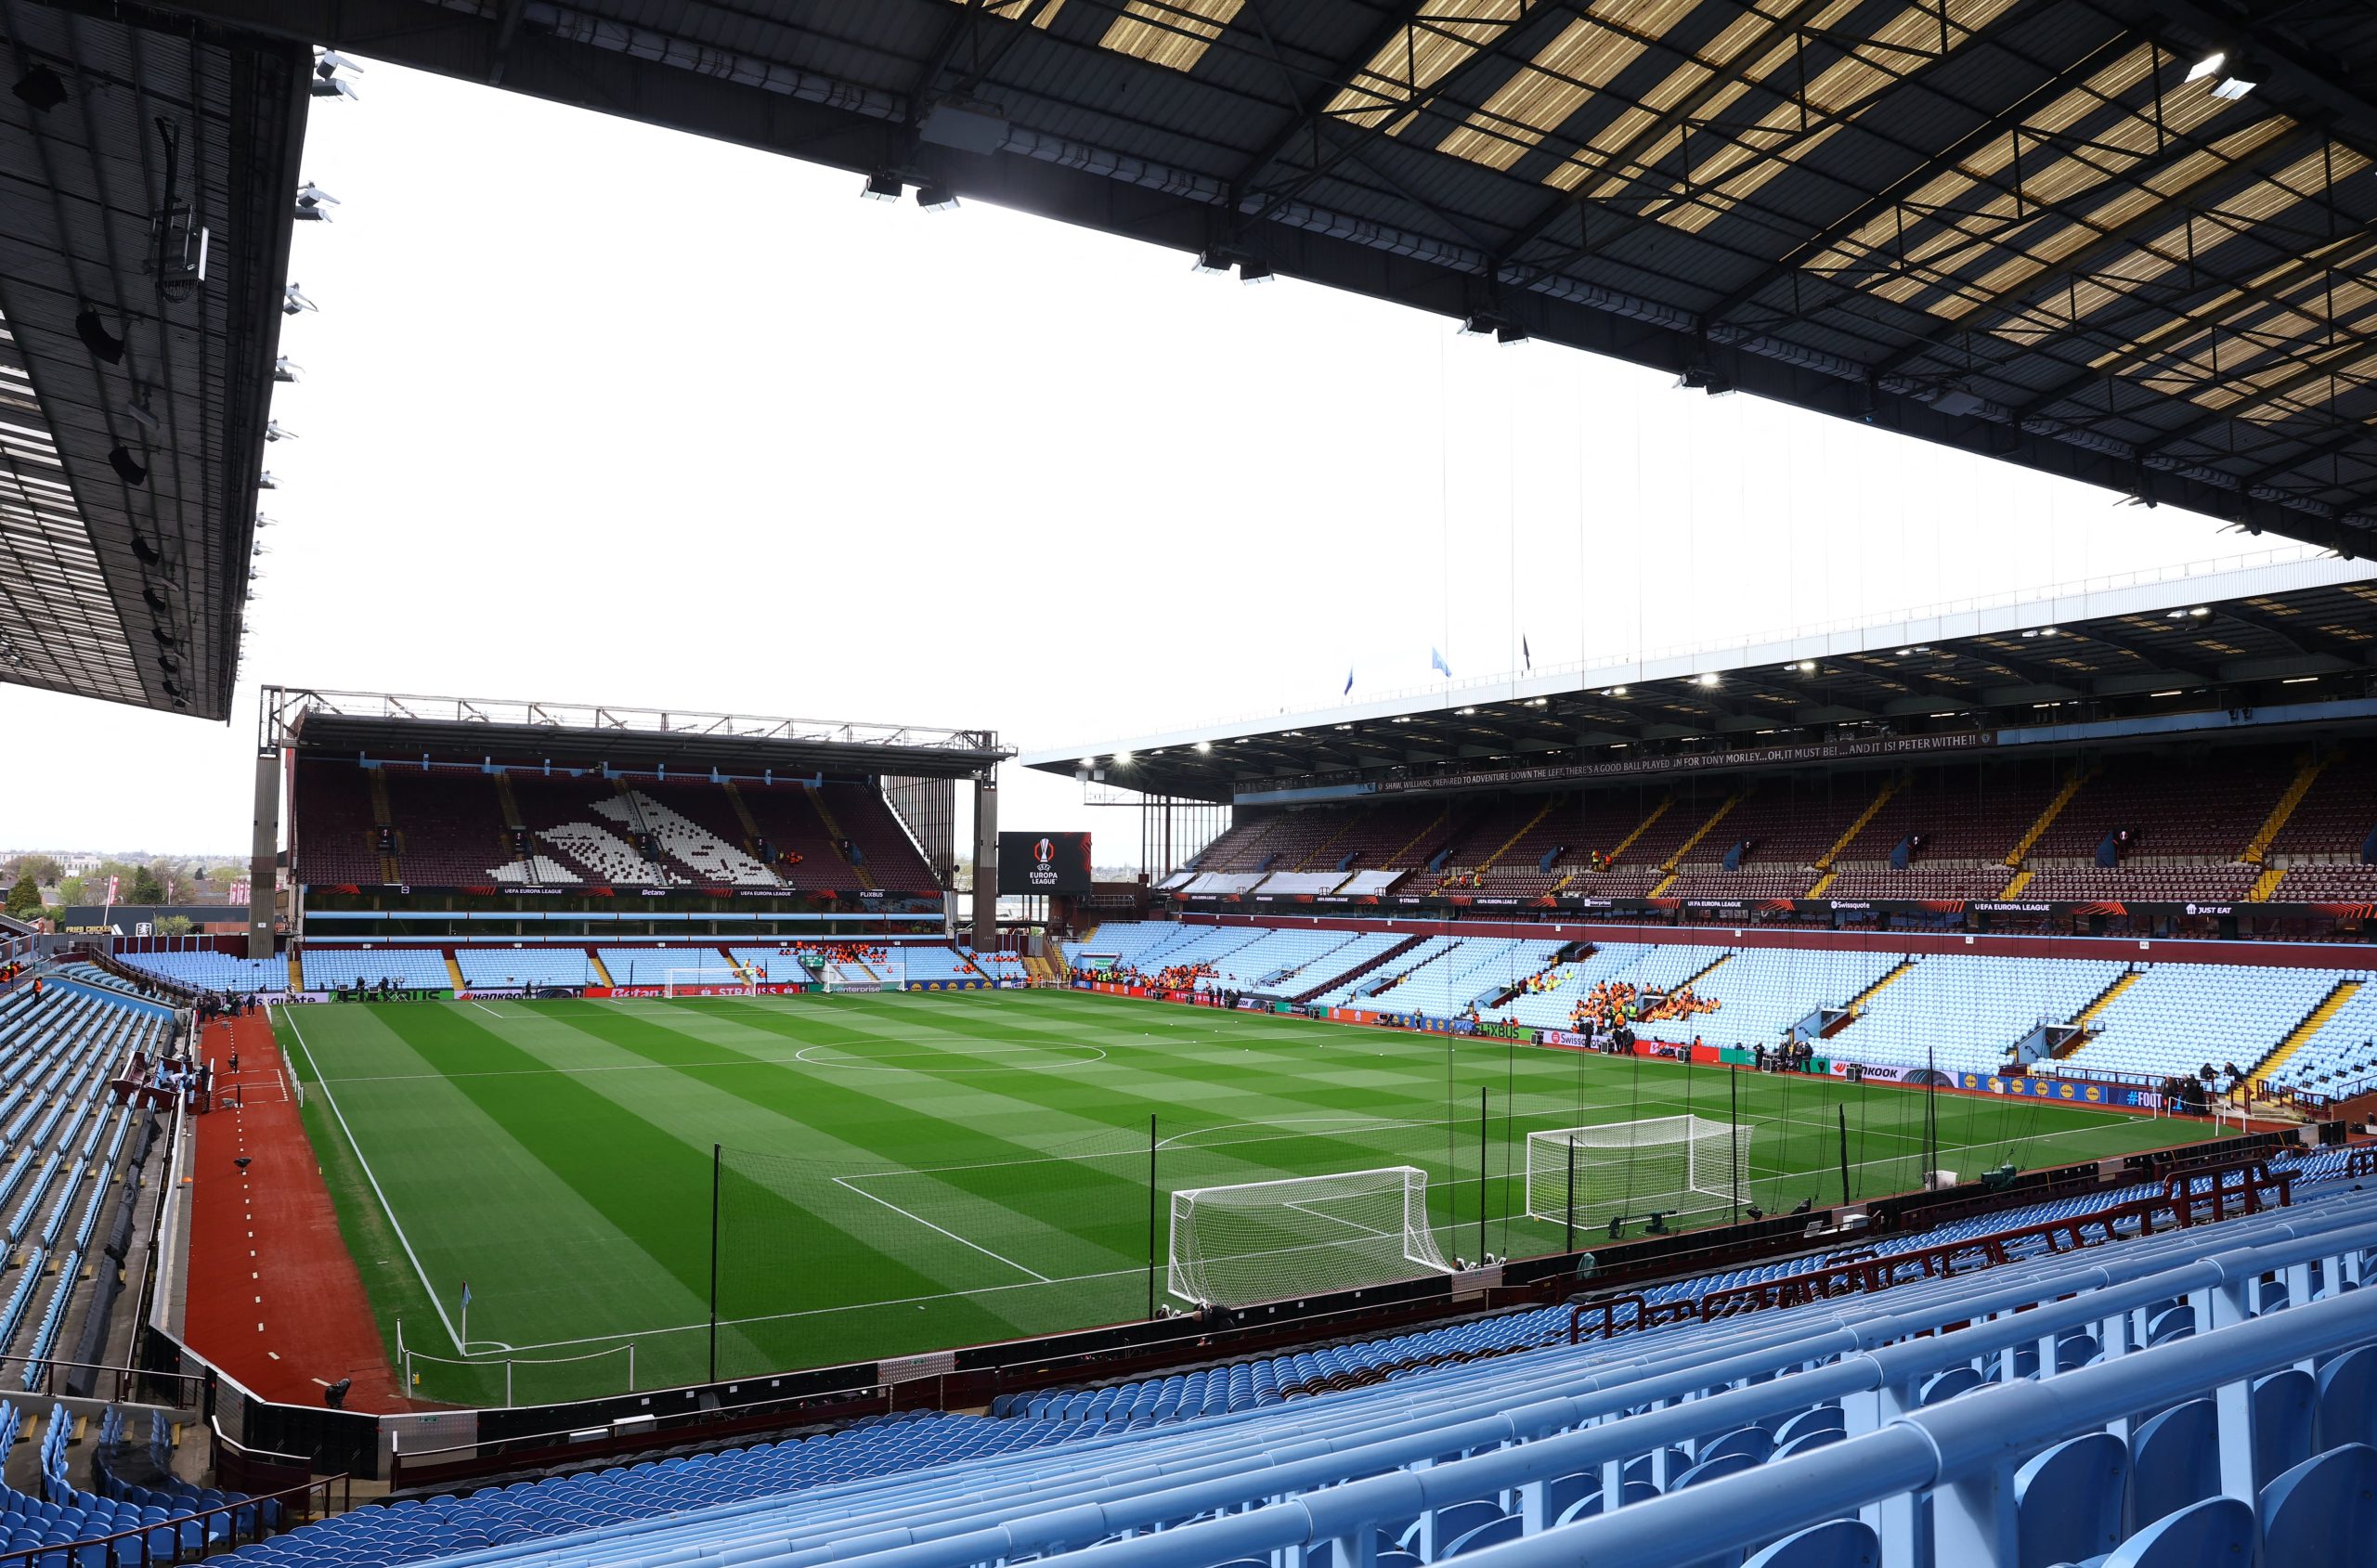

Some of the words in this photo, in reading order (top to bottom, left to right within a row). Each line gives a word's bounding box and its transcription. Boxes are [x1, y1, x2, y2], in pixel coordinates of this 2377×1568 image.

[1433, 777, 1461, 786] PREPARED
[1472, 772, 1509, 784] ADVENTURE
[1511, 771, 1532, 780] DOWN
[1533, 769, 1546, 778] THE
[1565, 765, 1592, 775] THERE'S
[1593, 765, 1599, 773] A
[1599, 763, 1621, 772] GOOD
[1623, 761, 1642, 771] BALL
[1643, 759, 1669, 770] PLAYED
[1673, 758, 1682, 767] IN
[1683, 757, 1699, 767] FOR
[1701, 755, 1724, 765] TONY
[1785, 749, 1793, 759] IT
[1795, 747, 1821, 758] MUST
[1872, 743, 1880, 752] IT
[1899, 738, 1930, 750] PETER
[1036, 862, 1052, 872] UEFA
[1838, 901, 1870, 910] Swissquote
